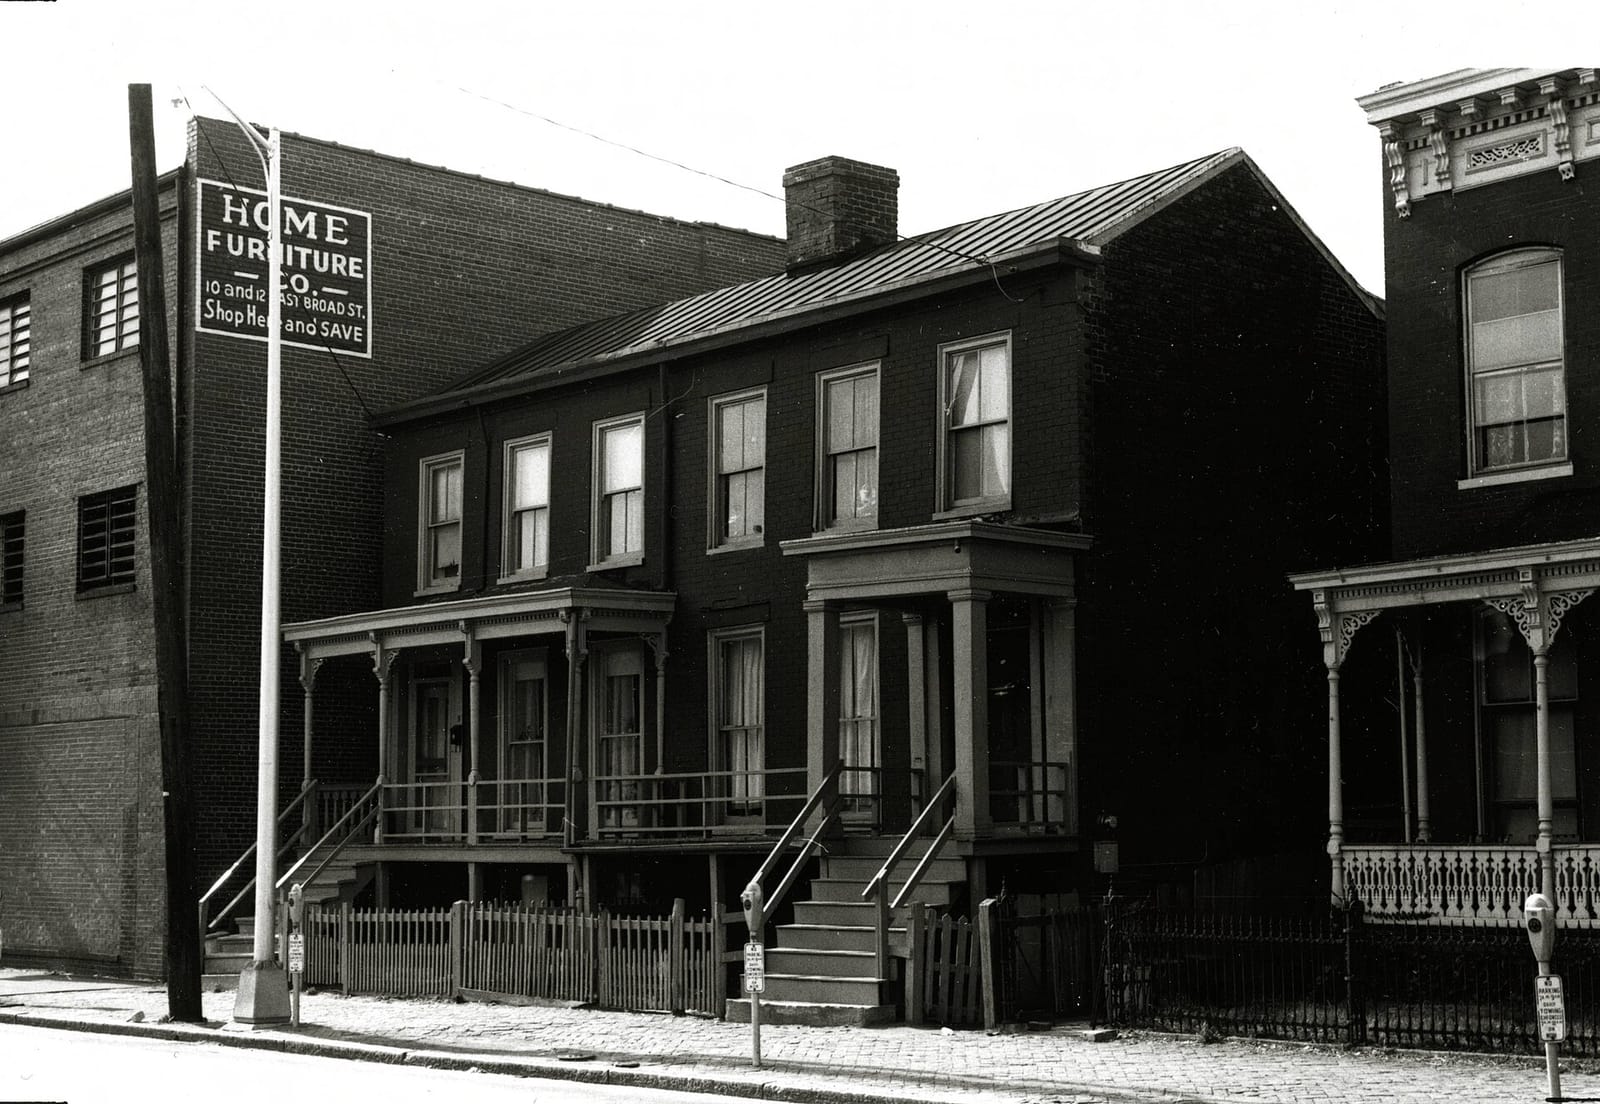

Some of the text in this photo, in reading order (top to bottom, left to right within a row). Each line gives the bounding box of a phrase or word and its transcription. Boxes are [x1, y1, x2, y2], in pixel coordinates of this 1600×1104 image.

[222, 194, 349, 245] HOME
[204, 299, 363, 343] Shop He and SAVE
[206, 280, 366, 320] 10 and 12 AST BROAD ST.
